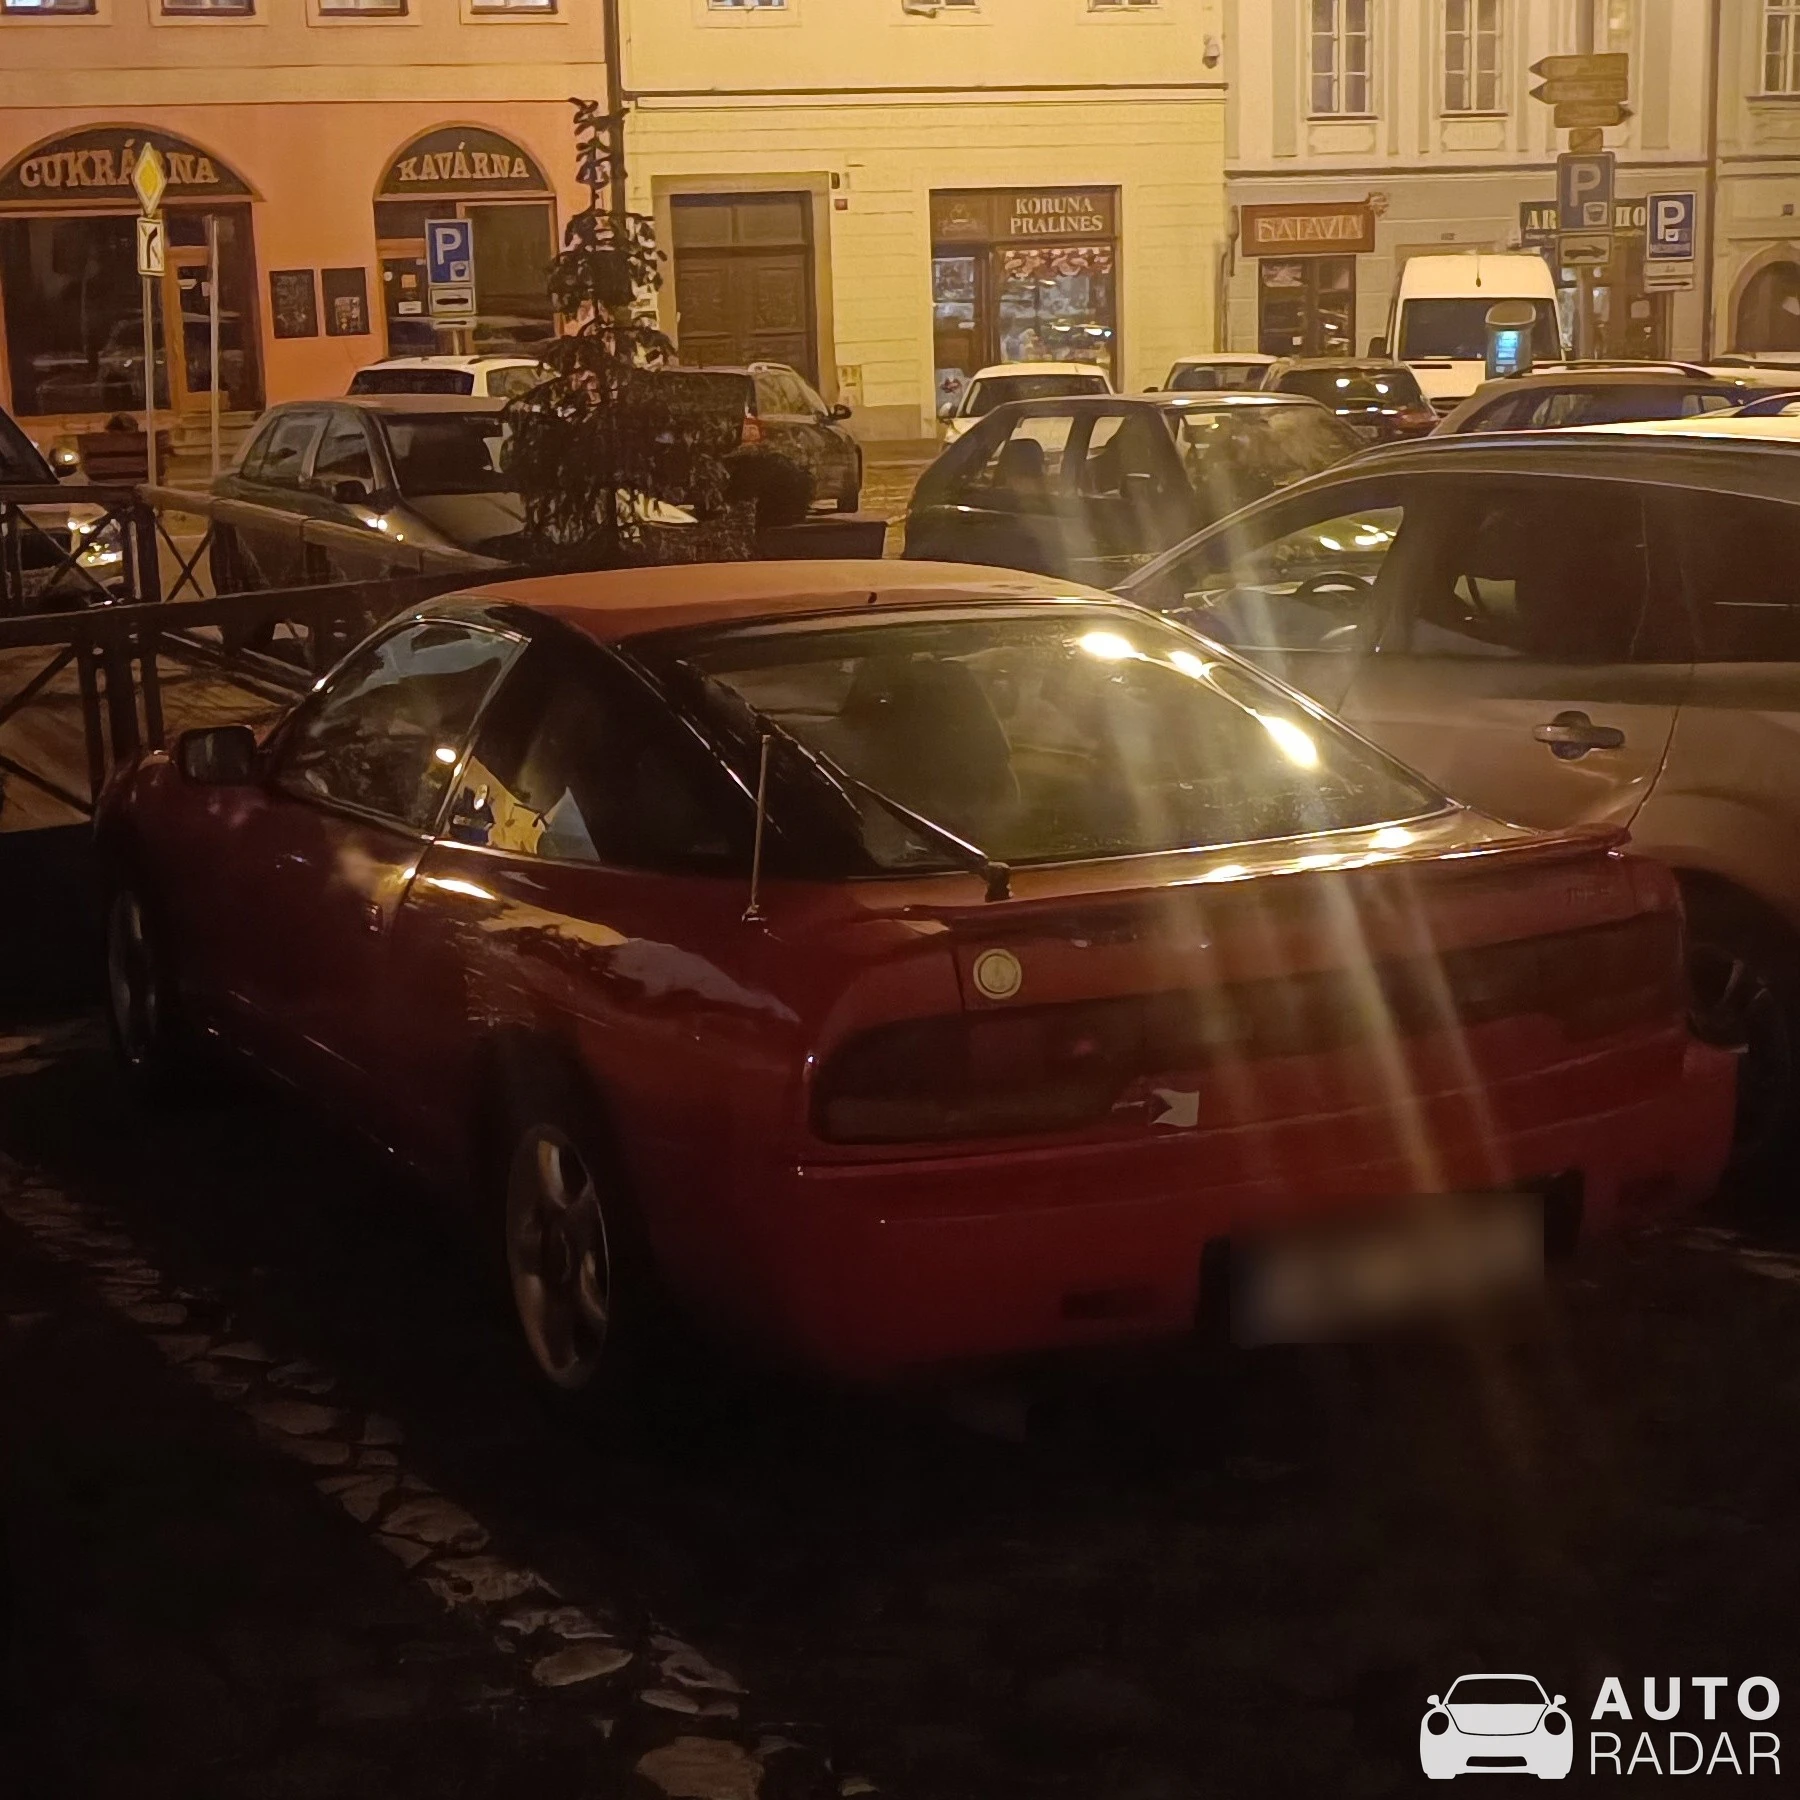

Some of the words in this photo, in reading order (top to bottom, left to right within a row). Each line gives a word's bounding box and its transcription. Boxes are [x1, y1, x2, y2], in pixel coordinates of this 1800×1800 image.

[20, 138, 219, 188] CUKRÁNA
[398, 141, 529, 181] KAVÁRNA
[1570, 163, 1600, 207] P
[1010, 214, 1103, 235] PRALINES
[1016, 196, 1094, 215] KORUNA
[1657, 200, 1685, 240] P
[435, 227, 463, 266] P
